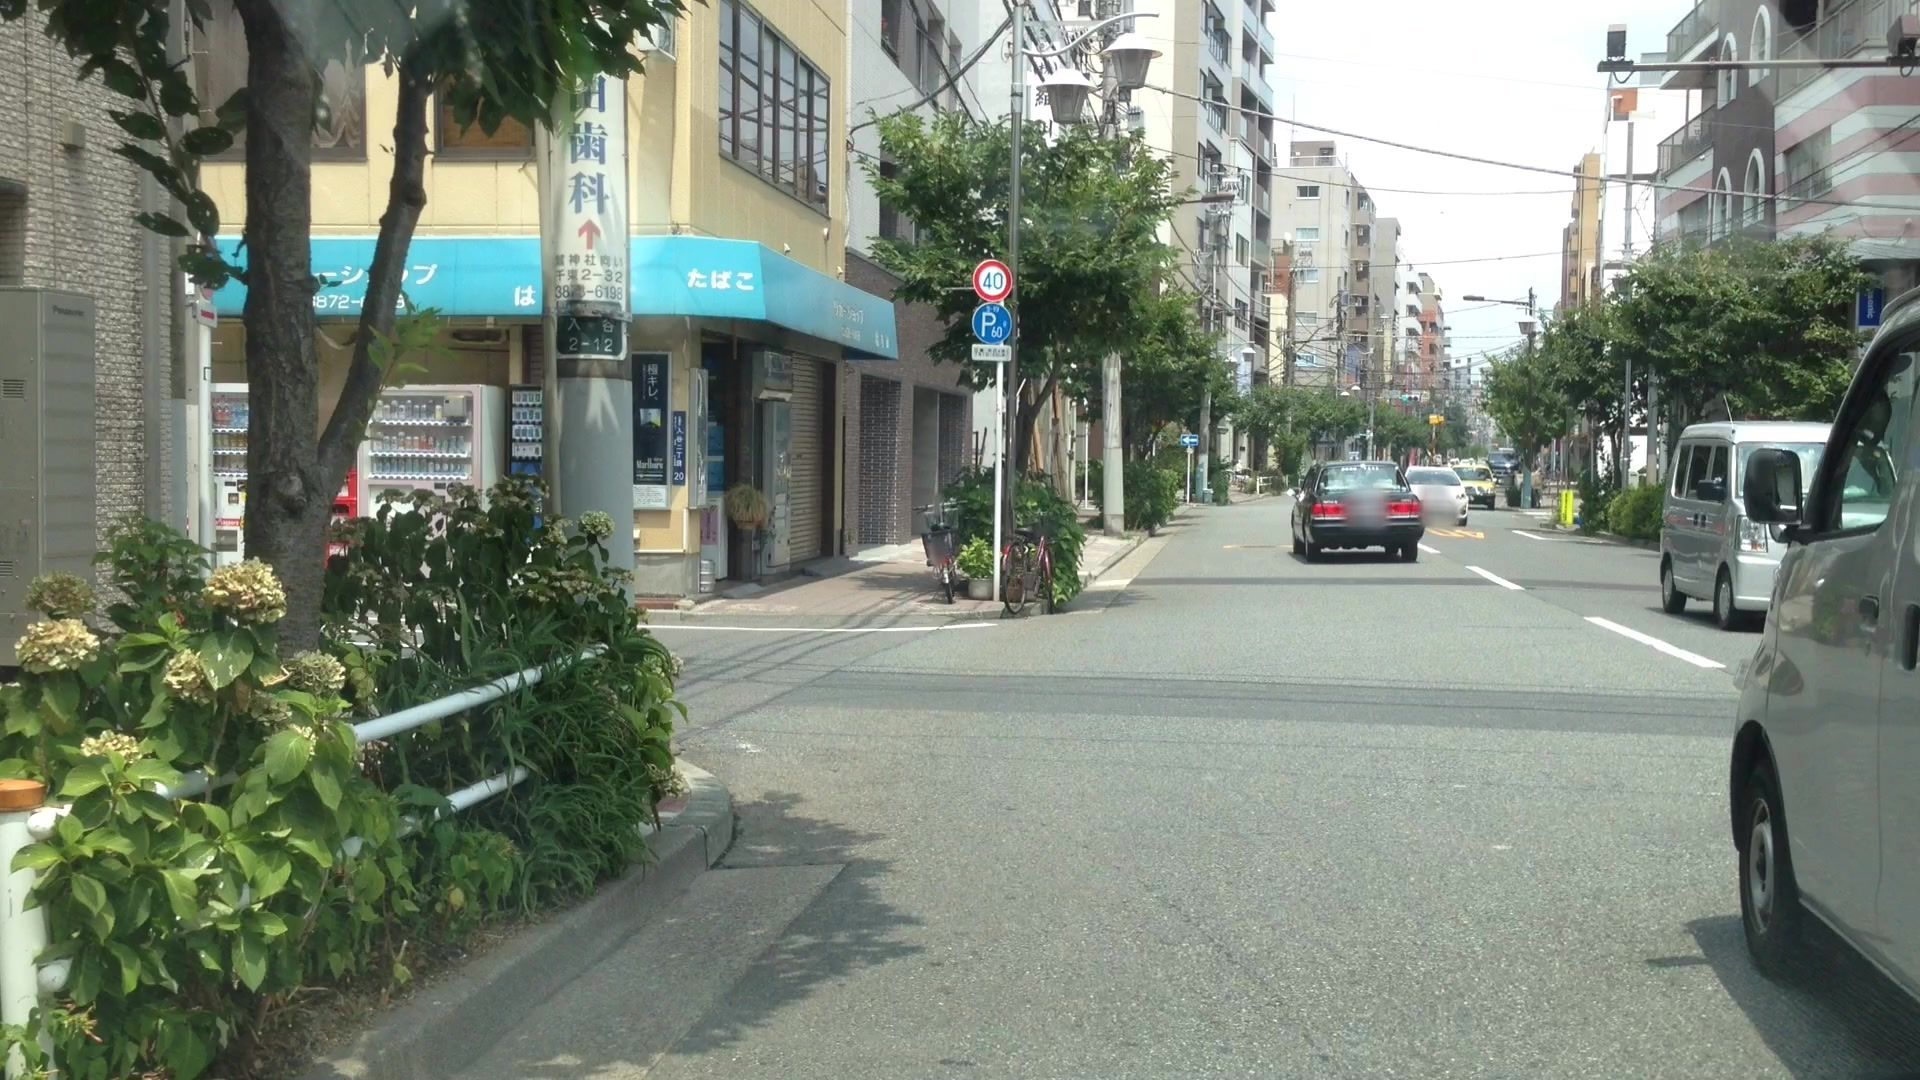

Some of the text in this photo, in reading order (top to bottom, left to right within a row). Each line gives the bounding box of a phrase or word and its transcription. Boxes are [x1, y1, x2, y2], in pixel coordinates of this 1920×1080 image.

[687, 267, 755, 291] たばこ
[982, 271, 1004, 290] 40
[568, 318, 615, 333] 入谷
[981, 311, 1003, 338] P 60
[568, 338, 613, 353] 2-12
[636, 457, 664, 469] Marlboro
[674, 472, 685, 481] 20
